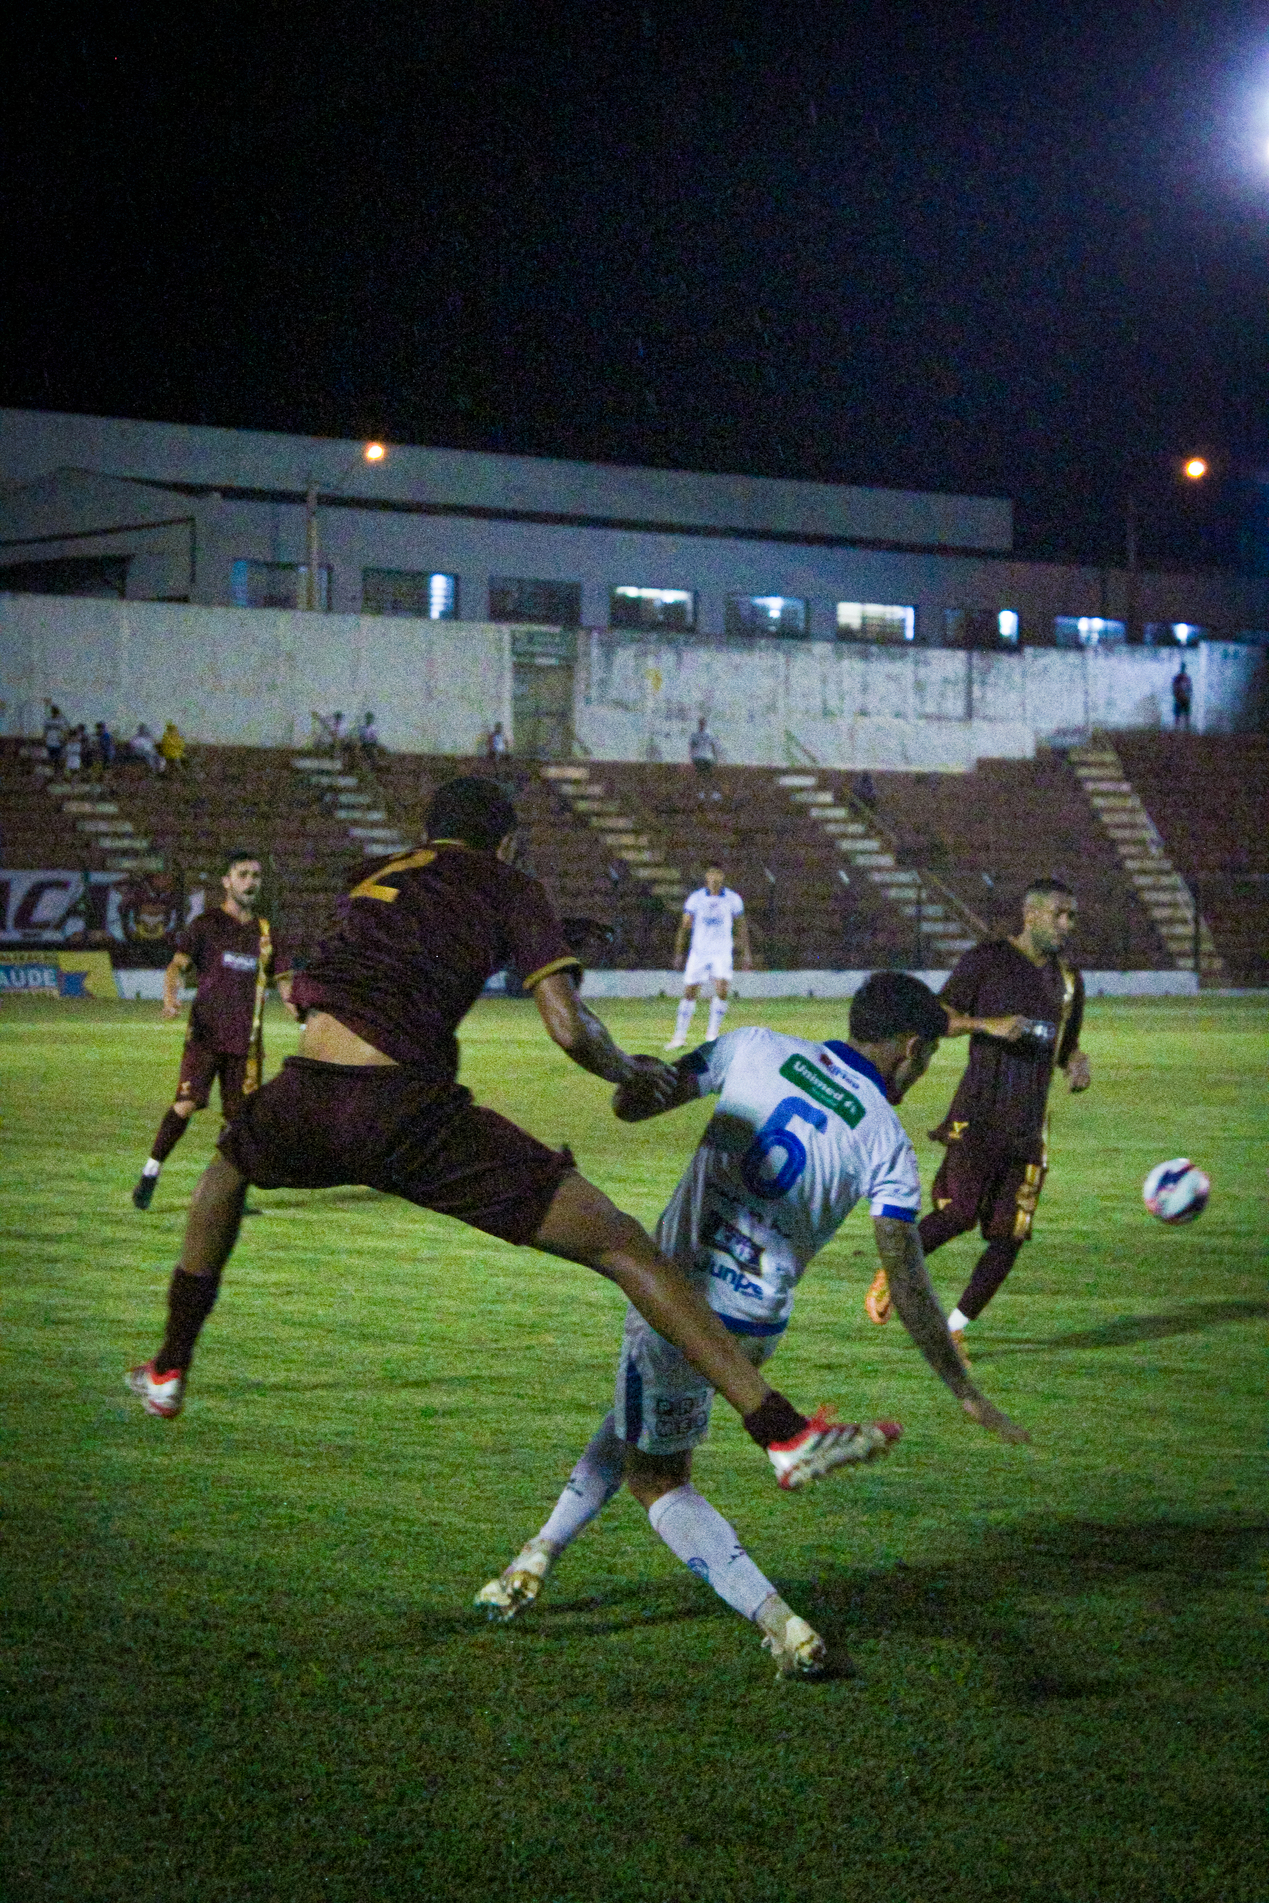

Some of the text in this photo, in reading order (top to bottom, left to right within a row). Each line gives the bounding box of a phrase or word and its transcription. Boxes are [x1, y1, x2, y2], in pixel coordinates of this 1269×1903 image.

[349, 849, 436, 903] 2
[793, 1060, 845, 1102] Unimed
[740, 1096, 828, 1199] 6
